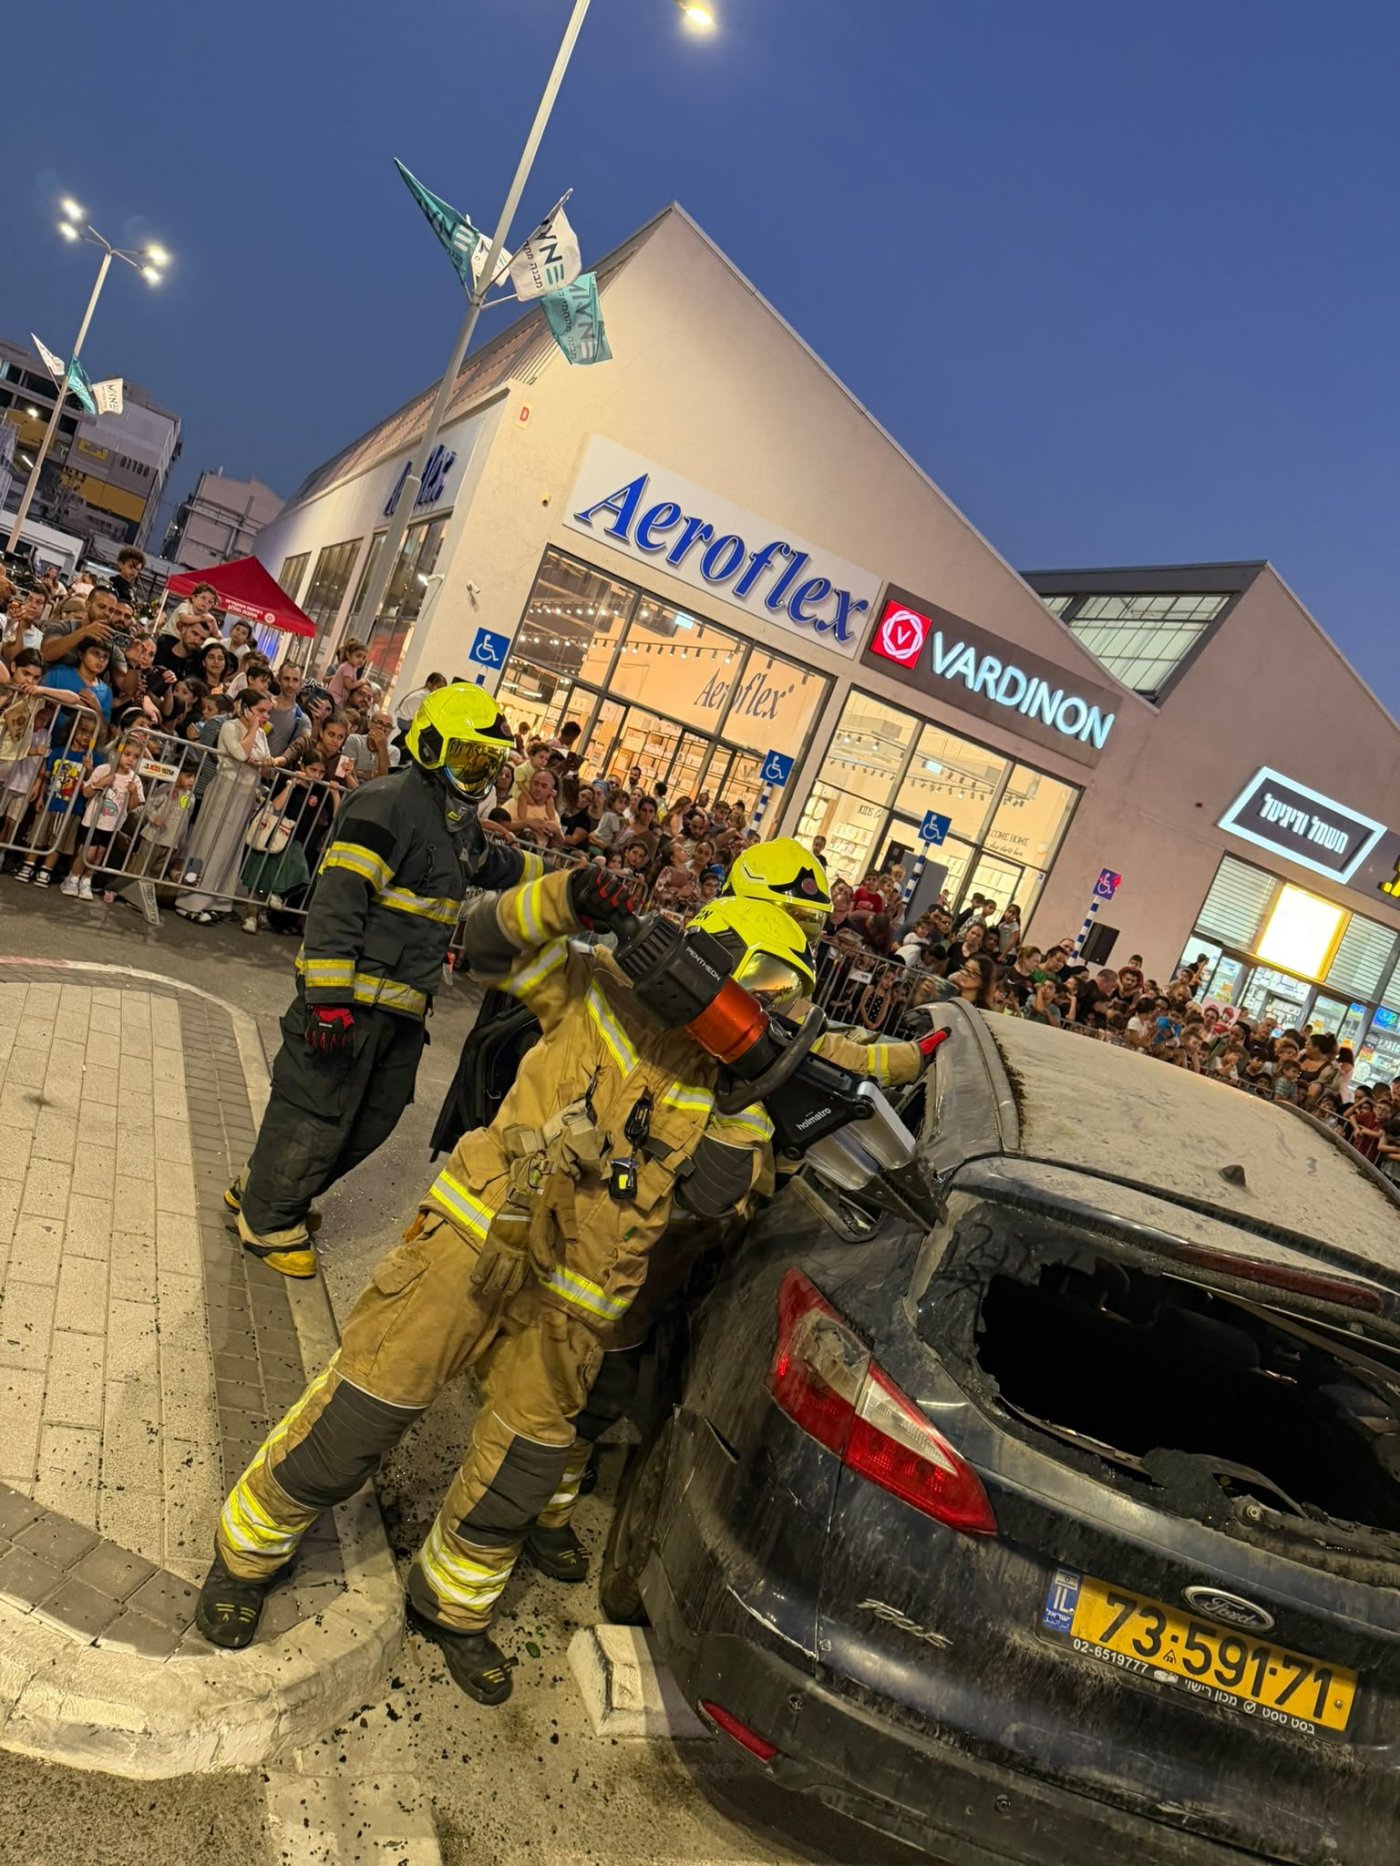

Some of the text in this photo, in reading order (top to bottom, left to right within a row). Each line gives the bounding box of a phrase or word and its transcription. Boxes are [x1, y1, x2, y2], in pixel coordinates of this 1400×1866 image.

[529, 262, 544, 290] מבנה
[519, 406, 530, 422] D
[573, 472, 869, 644] Aeroflex
[932, 630, 1116, 750] VARDINON
[1259, 792, 1349, 855] חשמל ודיגיטל
[686, 946, 721, 983] PENTHEON
[796, 1106, 833, 1132] holmatro
[1045, 1607, 1071, 1623] ישראל
[1053, 1585, 1071, 1614] IL
[1203, 1596, 1256, 1625] Ford
[1072, 1637, 1150, 1675] 02-6519777
[1184, 1678, 1316, 1735] בסט טסט מכון רישוי
